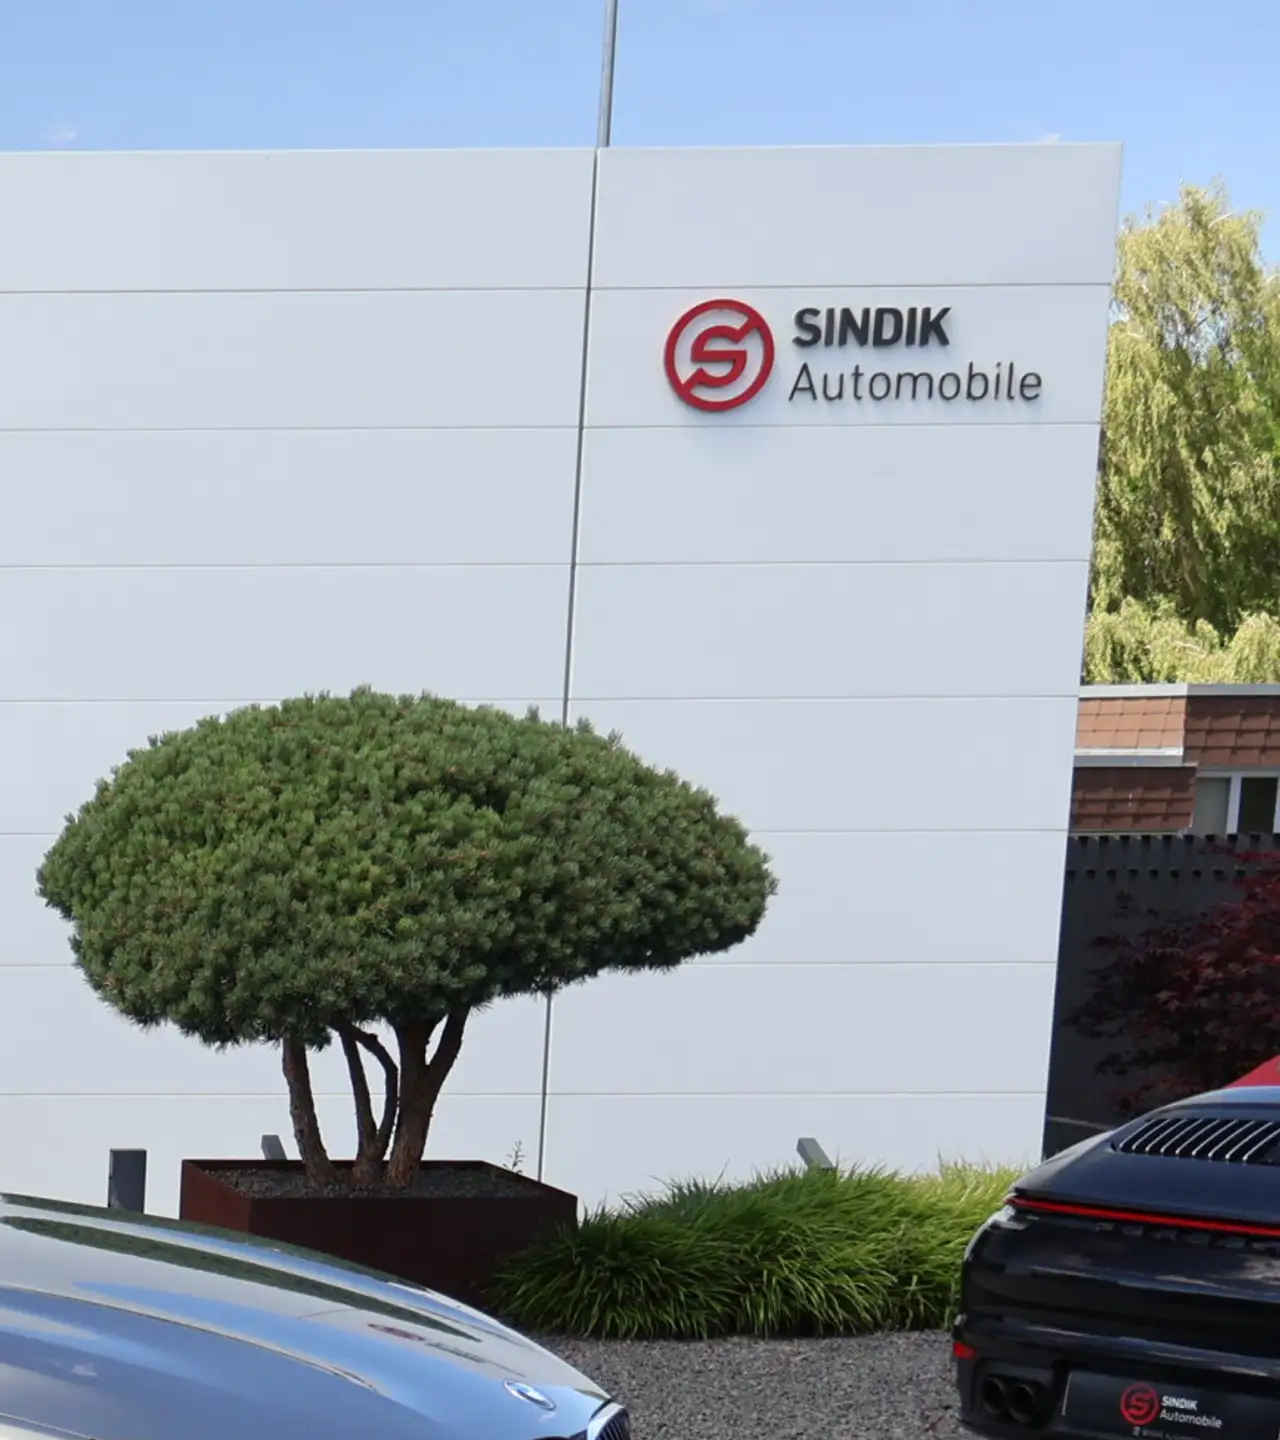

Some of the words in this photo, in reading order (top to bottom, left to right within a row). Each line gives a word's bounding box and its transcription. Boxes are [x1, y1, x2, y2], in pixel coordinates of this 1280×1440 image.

[792, 307, 952, 347] SINDIK
[788, 362, 1043, 401] Automobile
[1161, 1395, 1199, 1411] SINDIK
[1159, 1408, 1223, 1429] Automobile
